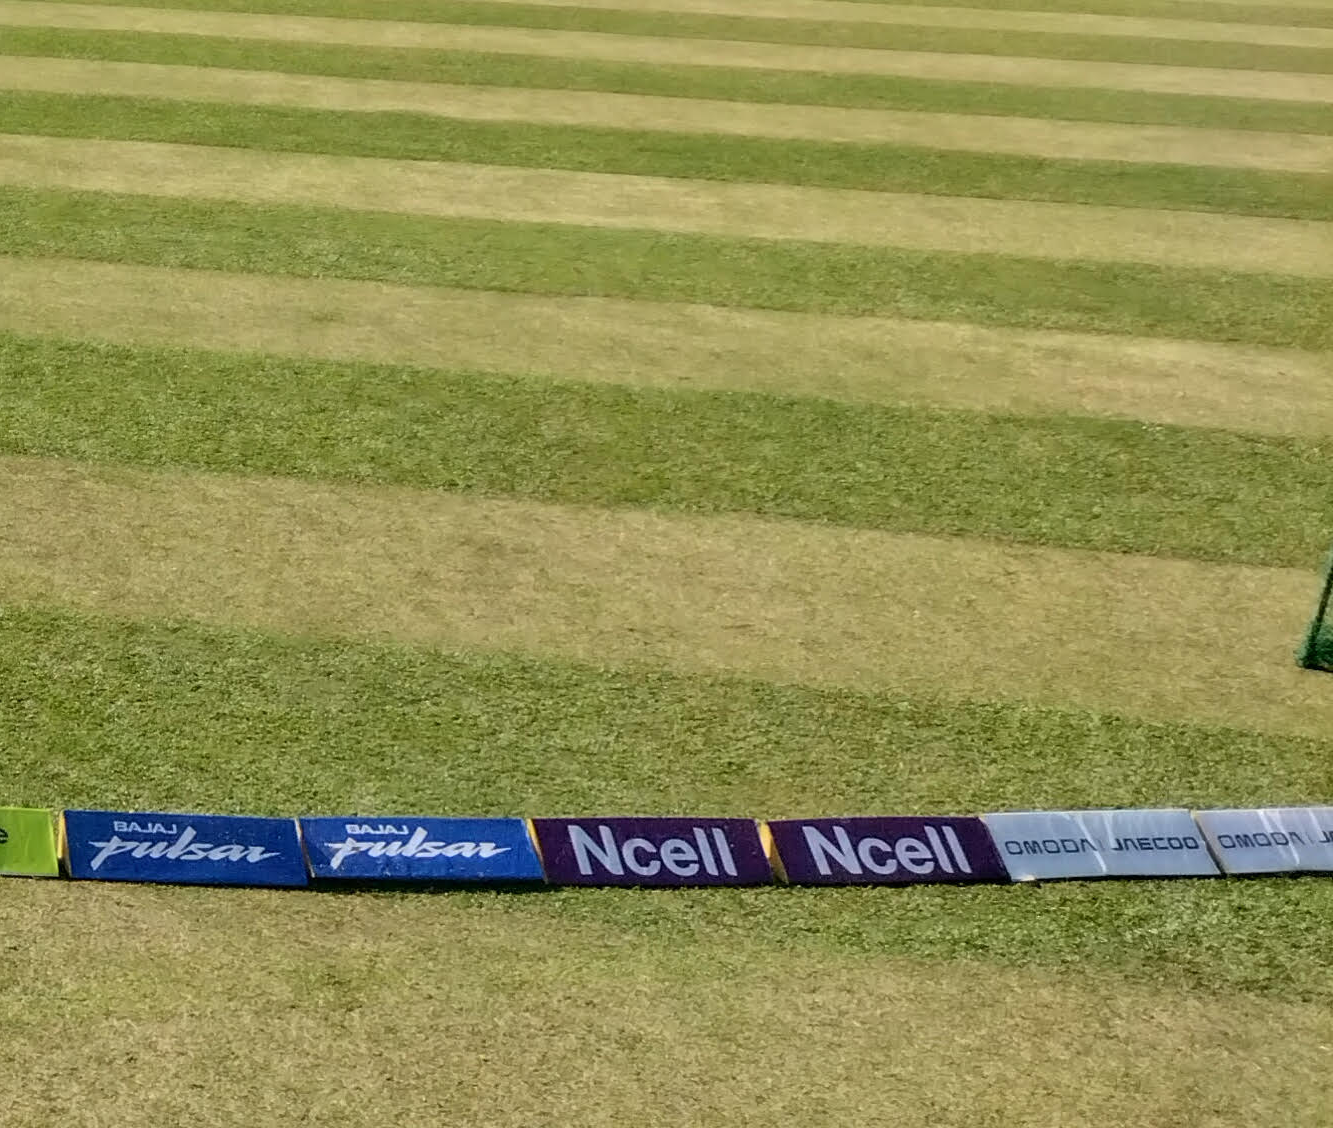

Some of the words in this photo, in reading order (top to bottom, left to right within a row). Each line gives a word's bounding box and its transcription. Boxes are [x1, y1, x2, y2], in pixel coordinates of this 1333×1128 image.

[113, 821, 178, 835] BAJAJ
[345, 822, 409, 835] BAJAJ
[1216, 832, 1304, 849] OMODA
[88, 825, 281, 871] pulsar
[326, 826, 513, 871] pulsar
[567, 824, 738, 877] Ncell
[802, 824, 973, 877] Ncell
[1004, 838, 1098, 855] OMODA
[1111, 835, 1200, 852] JAECOO
